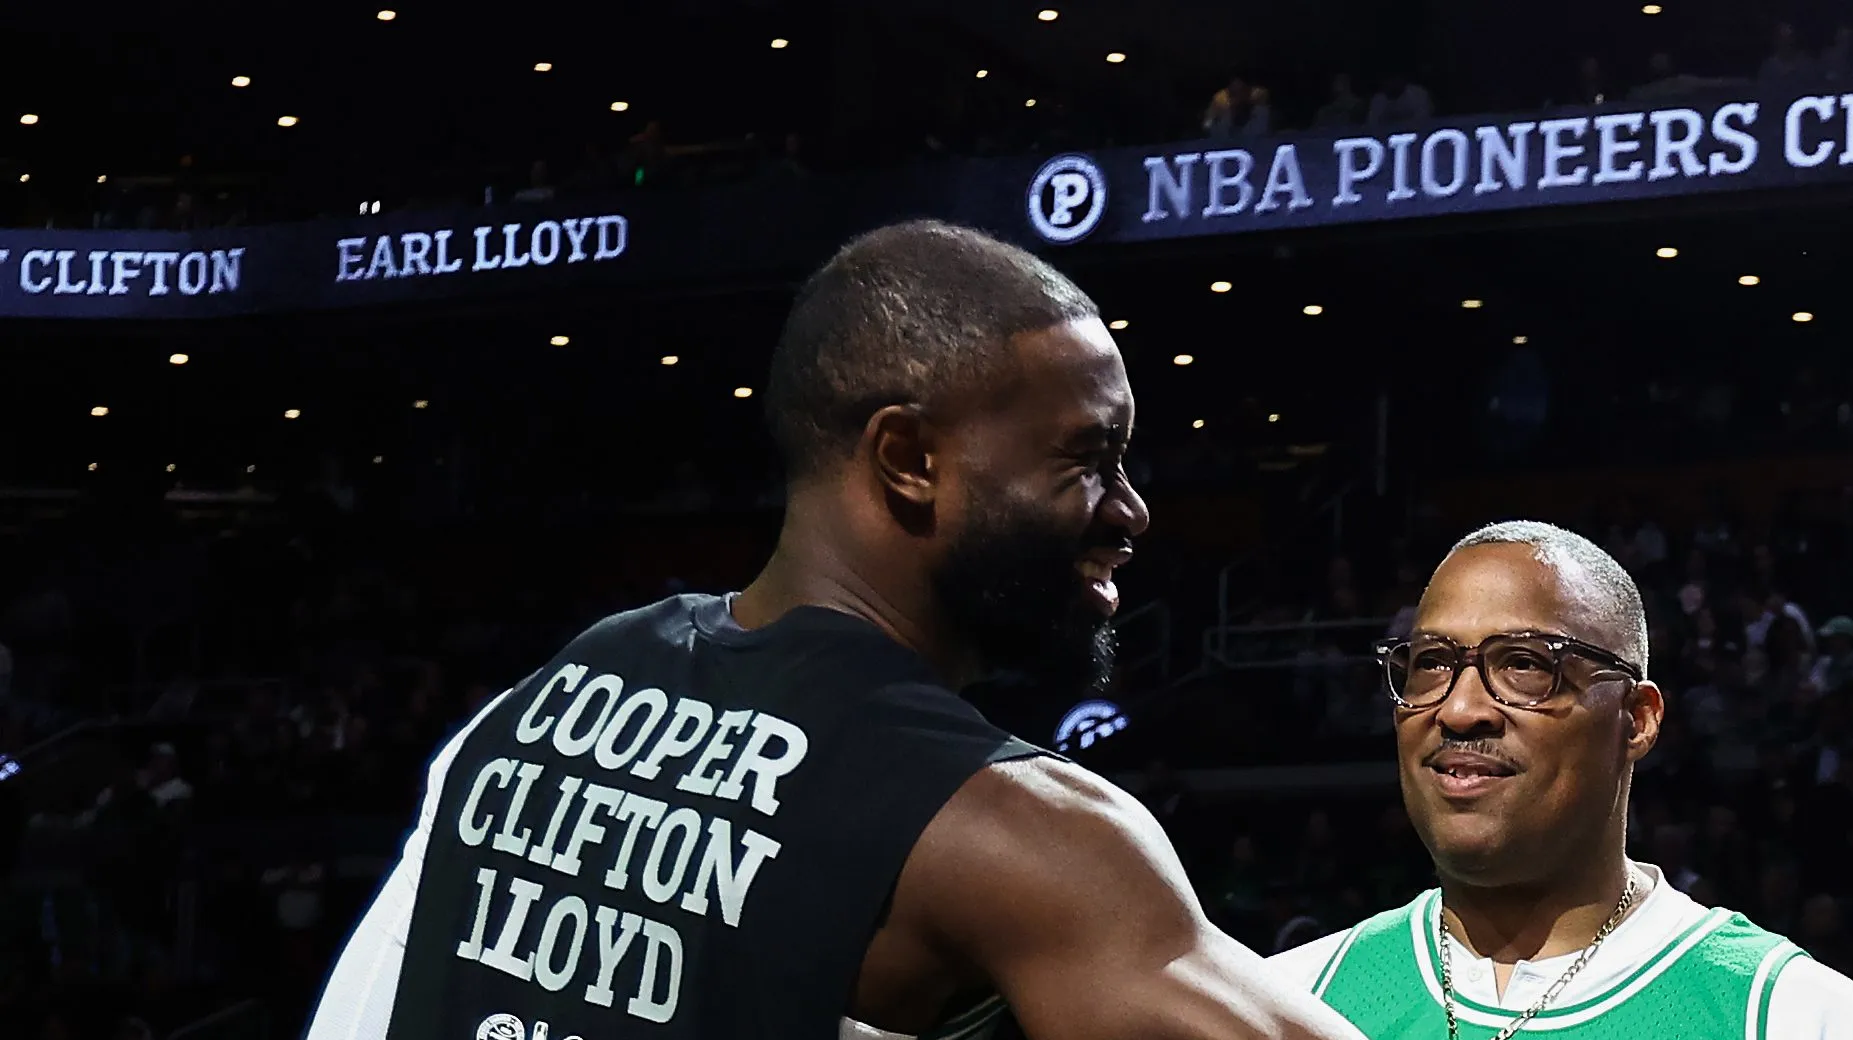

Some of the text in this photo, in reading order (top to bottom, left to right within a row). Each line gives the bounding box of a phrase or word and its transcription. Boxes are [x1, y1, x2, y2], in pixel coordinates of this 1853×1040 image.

[1141, 144, 1315, 223] NBA
[1332, 102, 1760, 206] PIONEERS
[20, 247, 244, 296] CLIFTON
[336, 214, 629, 282] EARL LLOYD
[516, 663, 808, 816] COOPER
[458, 757, 782, 928] CLIFTON
